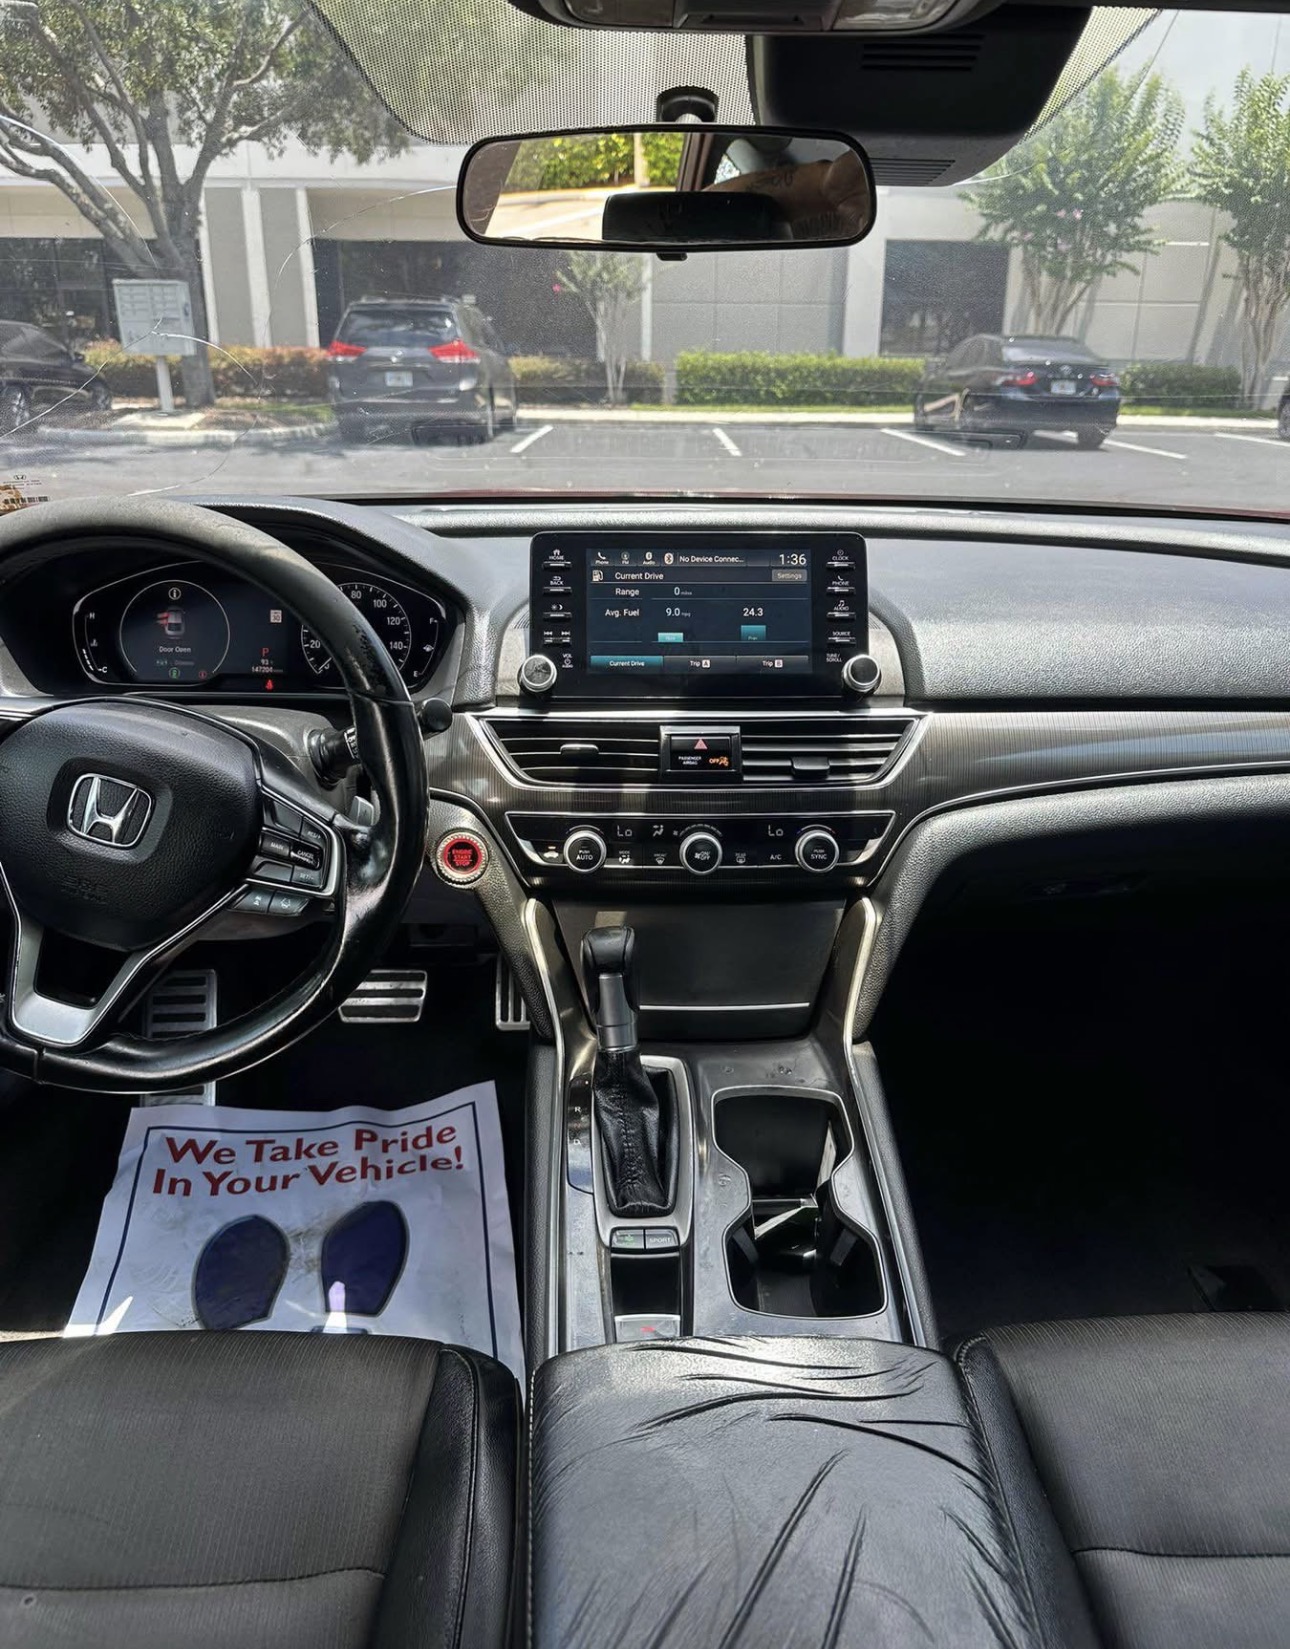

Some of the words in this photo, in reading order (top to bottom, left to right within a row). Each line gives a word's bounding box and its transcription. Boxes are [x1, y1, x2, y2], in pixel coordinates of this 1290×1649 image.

[679, 555, 690, 563] No
[690, 555, 713, 564] Device
[778, 553, 808, 566] 1:36
[614, 571, 643, 581] Current
[644, 571, 664, 581] Drive
[776, 572, 803, 581] Settings
[351, 590, 362, 600] 80
[615, 588, 640, 597] Range
[673, 586, 680, 596] 0
[373, 600, 387, 609] 100
[89, 612, 96, 620] H
[604, 609, 622, 619] Avg.
[623, 608, 640, 617] Fuel
[665, 607, 680, 617] 9.0
[742, 607, 764, 618] 24.3
[386, 616, 401, 626] 120
[310, 640, 321, 649] 20
[389, 641, 404, 651] 140
[262, 647, 270, 657] P
[690, 660, 701, 669] Trip
[762, 660, 774, 668] Trip
[270, 842, 284, 850] MAIN
[297, 850, 314, 859] CANCEL
[769, 853, 782, 861] A/C
[165, 1136, 237, 1165] We
[245, 1137, 340, 1164] Take
[354, 1125, 457, 1153] Pride
[152, 1168, 193, 1197] In
[203, 1168, 300, 1197] Your
[306, 1145, 465, 1186] Vehicle!
[649, 1236, 672, 1244] SPORT
